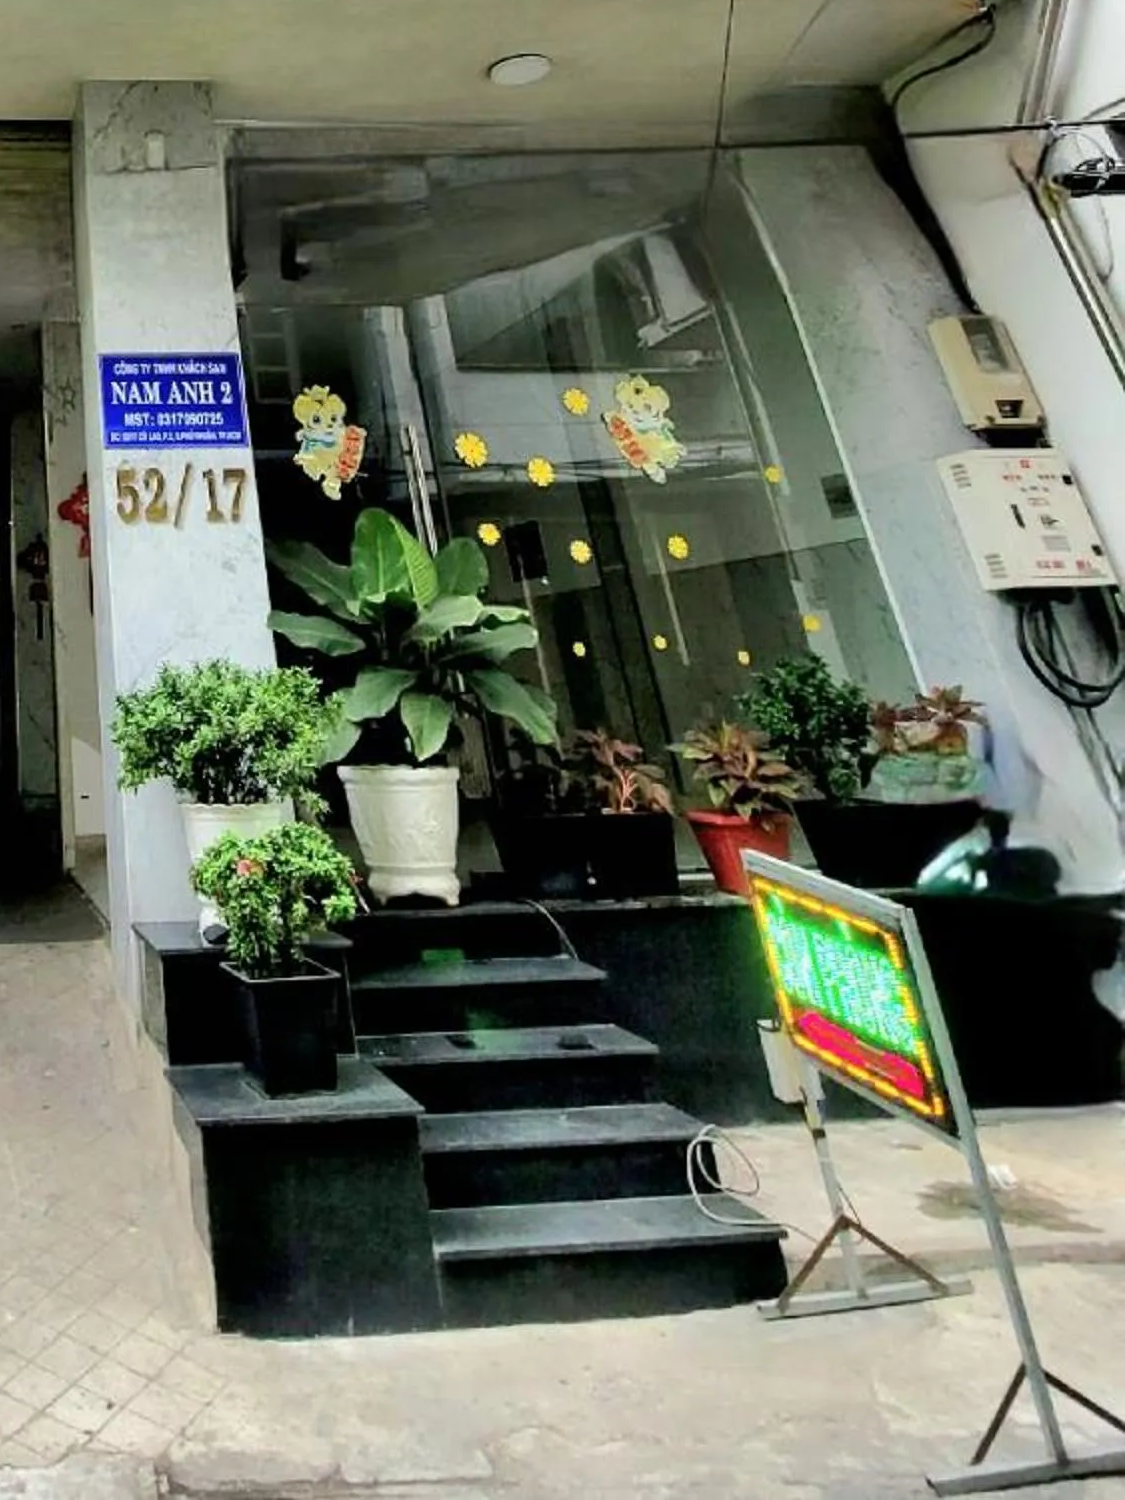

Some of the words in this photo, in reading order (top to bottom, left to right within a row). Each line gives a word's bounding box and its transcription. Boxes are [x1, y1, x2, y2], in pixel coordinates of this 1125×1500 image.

[110, 381, 161, 405] NAM
[167, 380, 216, 405] ANH
[220, 380, 234, 405] 2
[116, 462, 246, 528] 52/17
